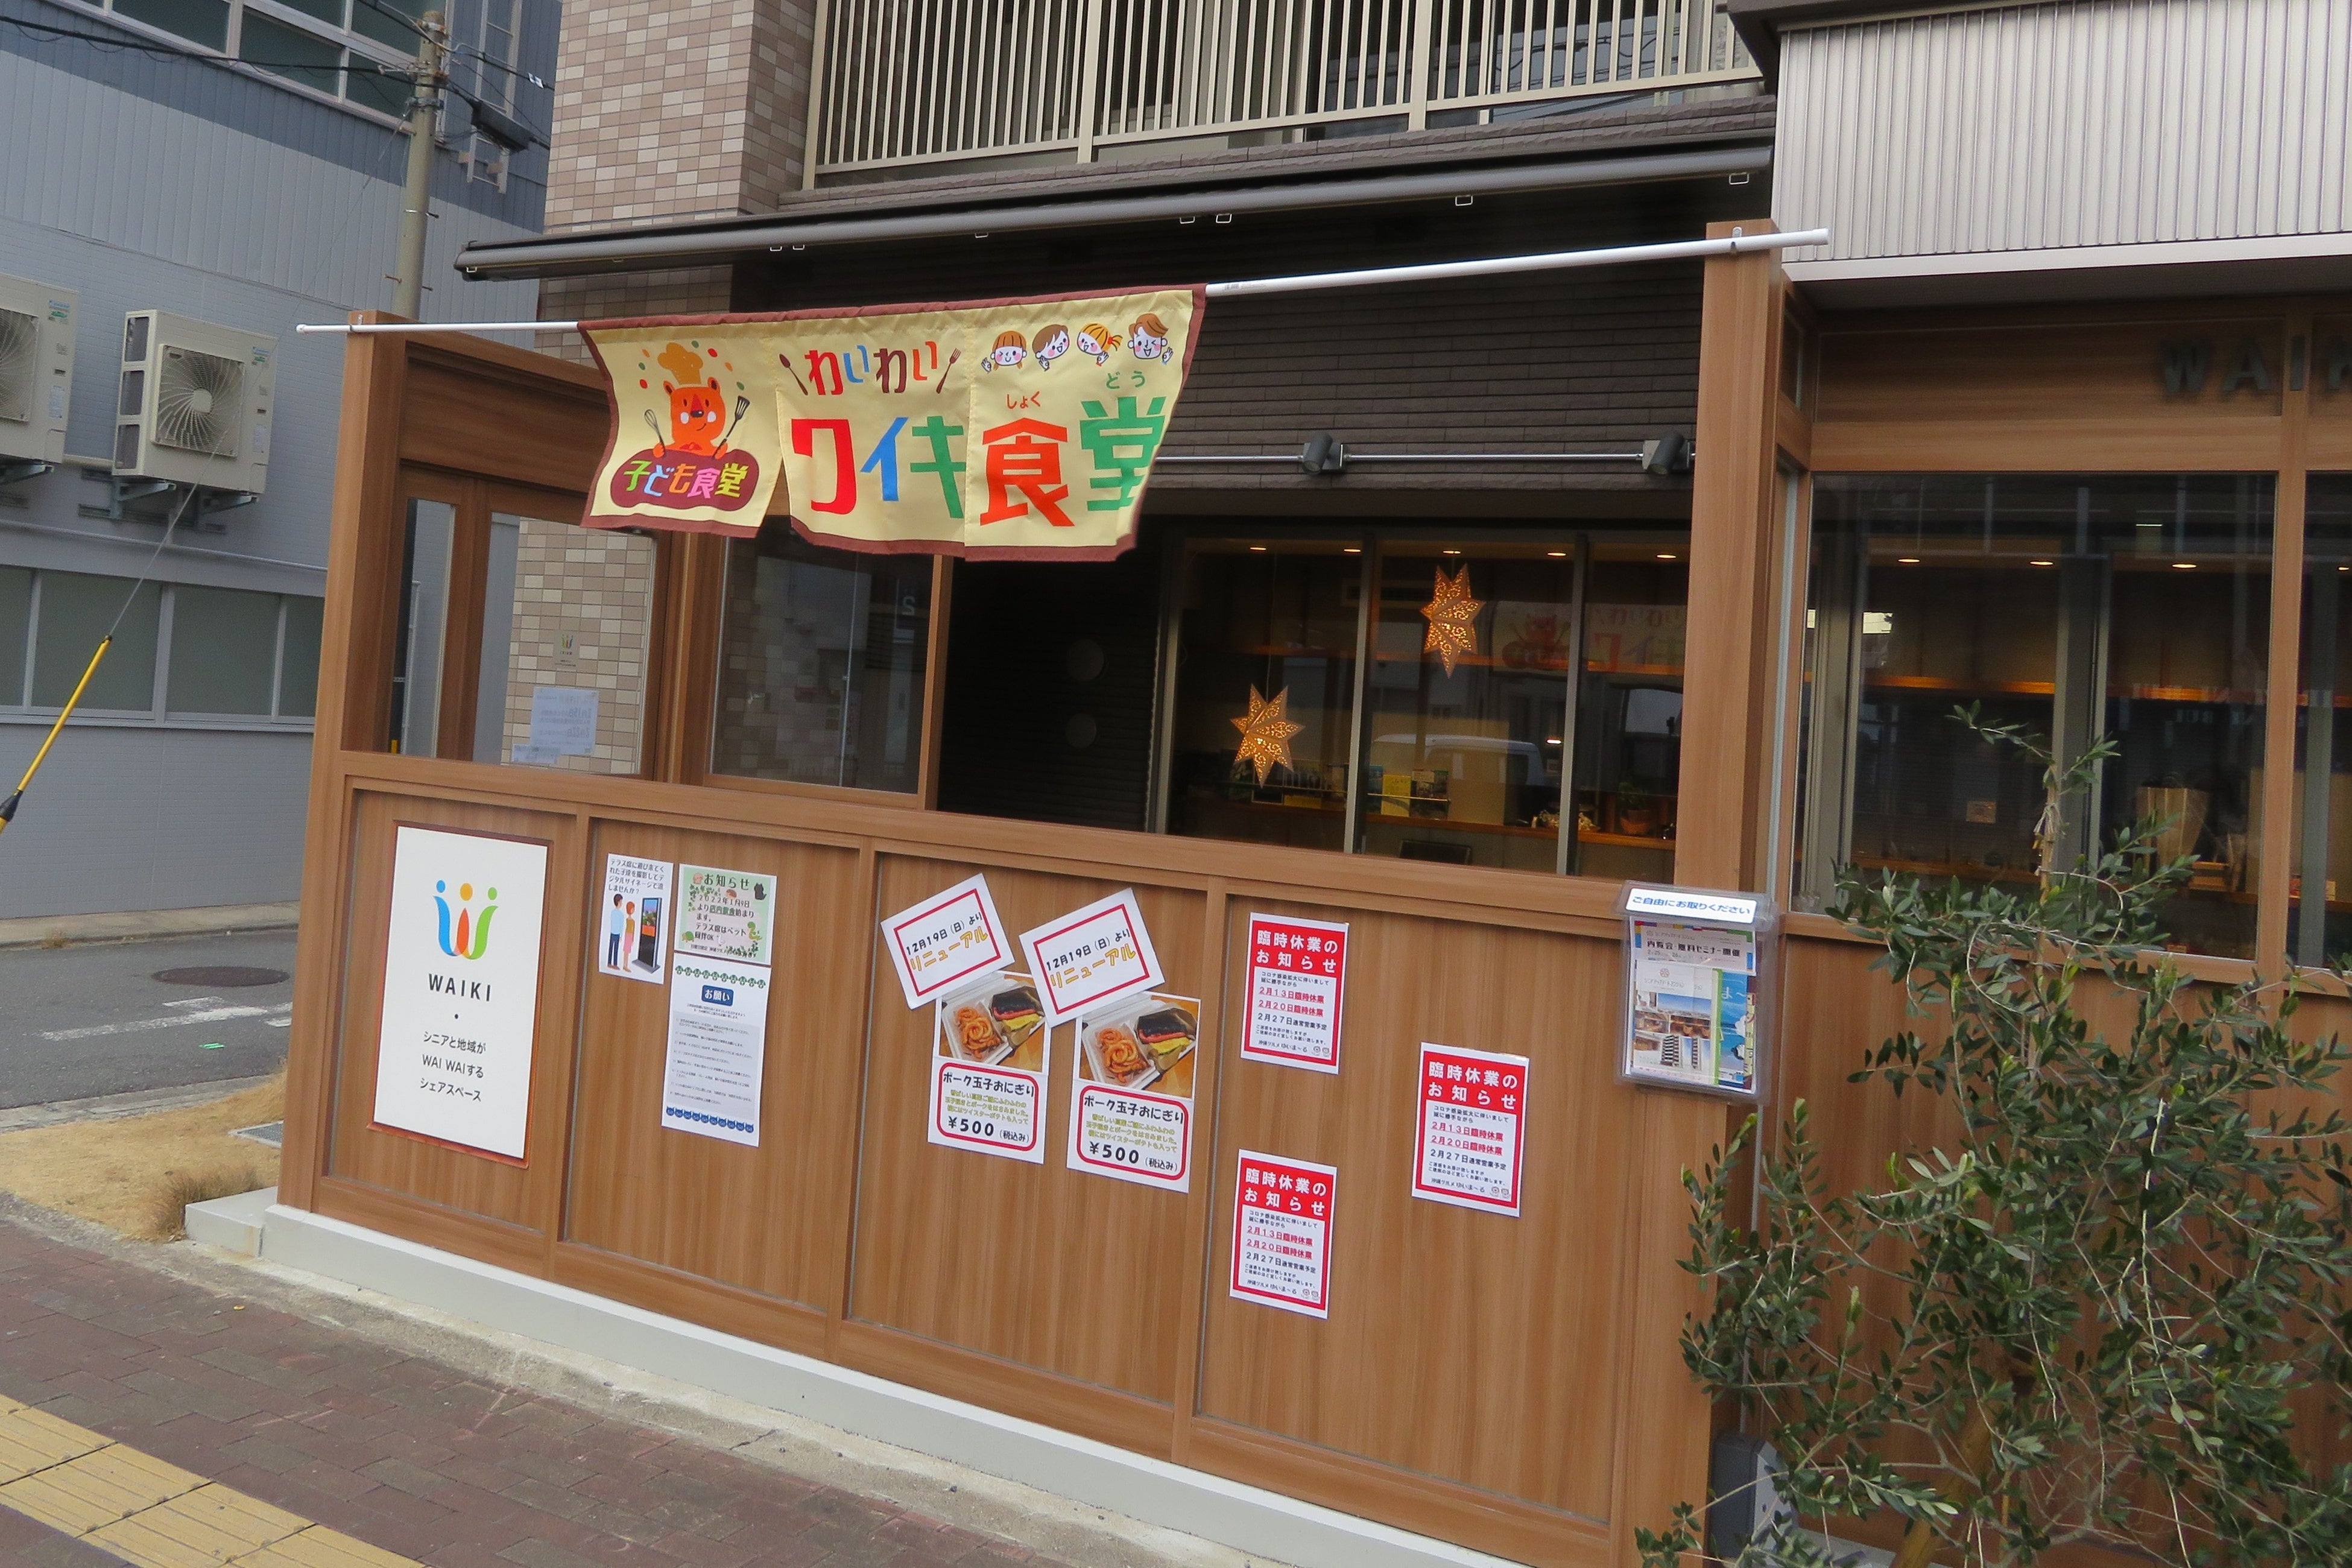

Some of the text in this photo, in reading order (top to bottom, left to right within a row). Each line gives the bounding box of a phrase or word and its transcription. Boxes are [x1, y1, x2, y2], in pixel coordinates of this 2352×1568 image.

[808, 341, 938, 395] わいわい
[1105, 370, 1145, 388] どう
[1006, 392, 1041, 409] しょく
[792, 396, 1165, 526] ワイキ食堂
[623, 460, 748, 499] 子ども食堂
[704, 874, 750, 890] お知らせ
[1633, 896, 1750, 914] ご自由にお取りください
[909, 926, 988, 972] リニューアル
[1257, 930, 1338, 953] 臨時休業の
[1050, 943, 1136, 988] リニューアル
[1256, 950, 1336, 973] お知らせ
[429, 974, 491, 1001] WAIKI
[704, 990, 730, 1001] お願い
[1259, 987, 1324, 1004] 2月13日臨時休業
[1258, 1000, 1323, 1017] 2月20日臨時休業
[423, 1031, 486, 1054] シニアと地域が
[422, 1054, 484, 1078] WAI WAIする
[1429, 1061, 1517, 1089] 臨時休業の
[420, 1078, 481, 1101] シェアスペース
[944, 1072, 1034, 1097] ポーク玉子おにぎり
[1428, 1082, 1516, 1110] お知らせ
[1084, 1095, 1183, 1124] ポーク玉子おにぎり
[948, 1116, 994, 1136] ¥500
[1431, 1122, 1503, 1141] 2月13日臨時休業
[1089, 1142, 1139, 1164] ¥500
[1430, 1135, 1502, 1155] 2月20日臨時休業
[1246, 1168, 1326, 1196] 臨時休業の
[1245, 1187, 1324, 1216] お知らせ
[1247, 1226, 1313, 1246] 2月13日臨時休業
[1247, 1239, 1312, 1260] 2月20日臨時休業
